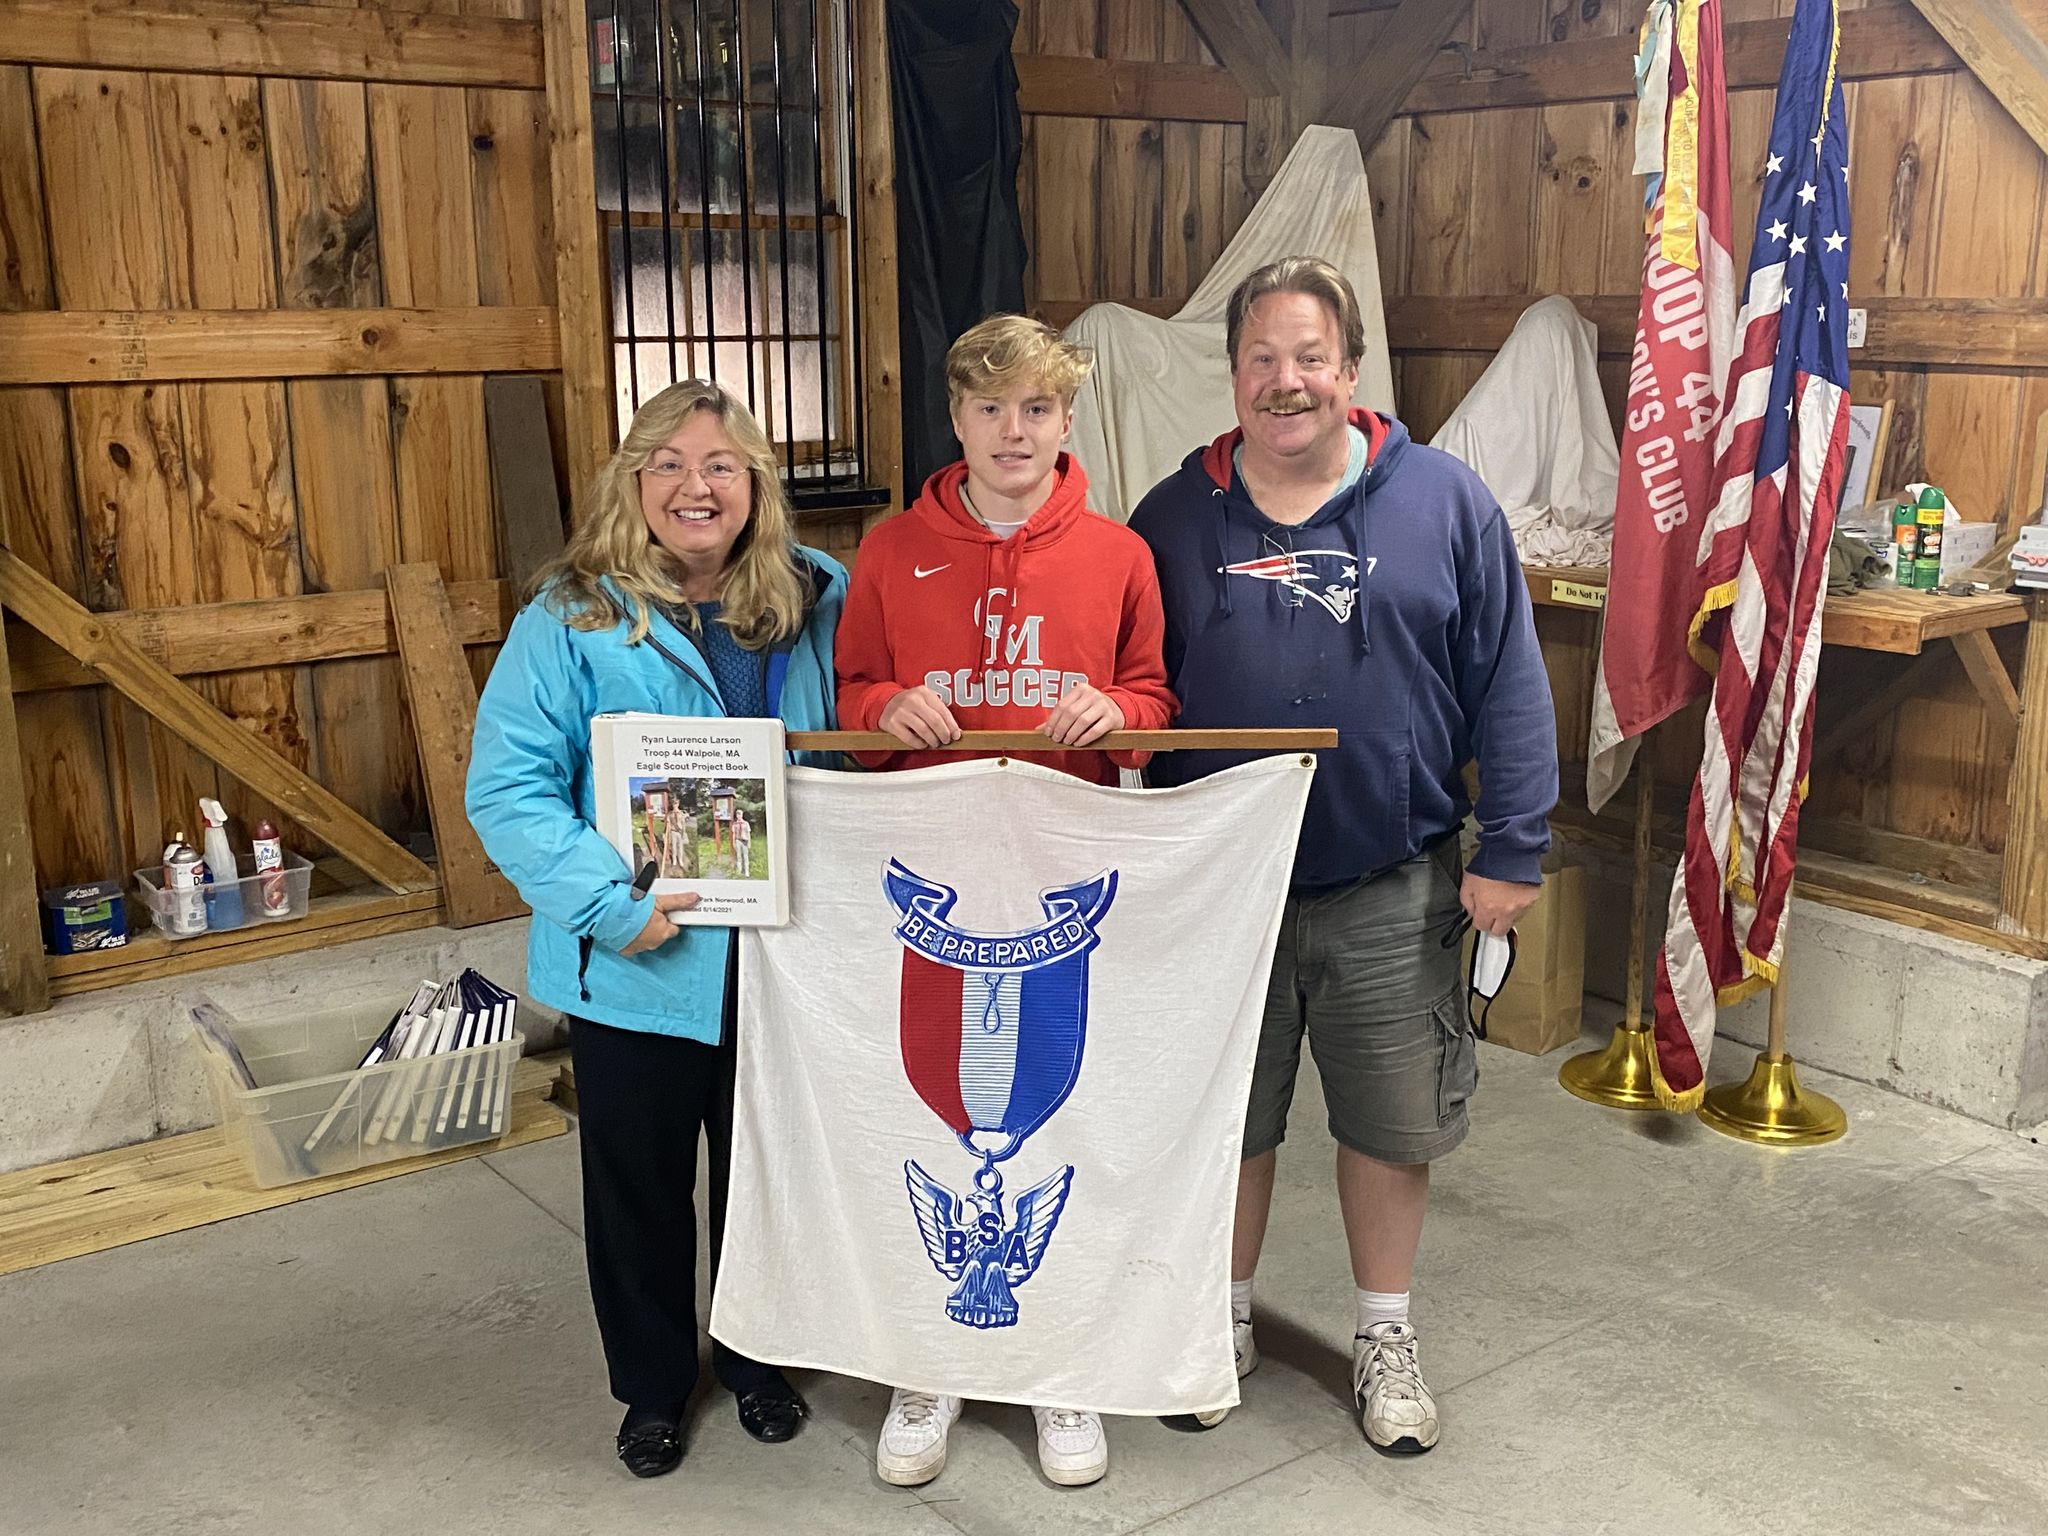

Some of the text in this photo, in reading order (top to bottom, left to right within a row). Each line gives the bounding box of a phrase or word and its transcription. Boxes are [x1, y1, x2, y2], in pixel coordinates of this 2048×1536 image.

[1675, 371, 1714, 443] 44
[1636, 435, 1689, 534] CLUB
[1566, 587, 1606, 601] Do Not To
[641, 735, 741, 745] Ryan Laurence Larson
[644, 749, 670, 758] Troop
[672, 749, 683, 757] 44
[685, 749, 723, 759] Walpole,
[636, 762, 749, 772] Eagle Scout Project Book
[256, 851, 280, 867] glade
[904, 916, 1083, 964] BE PREPARED
